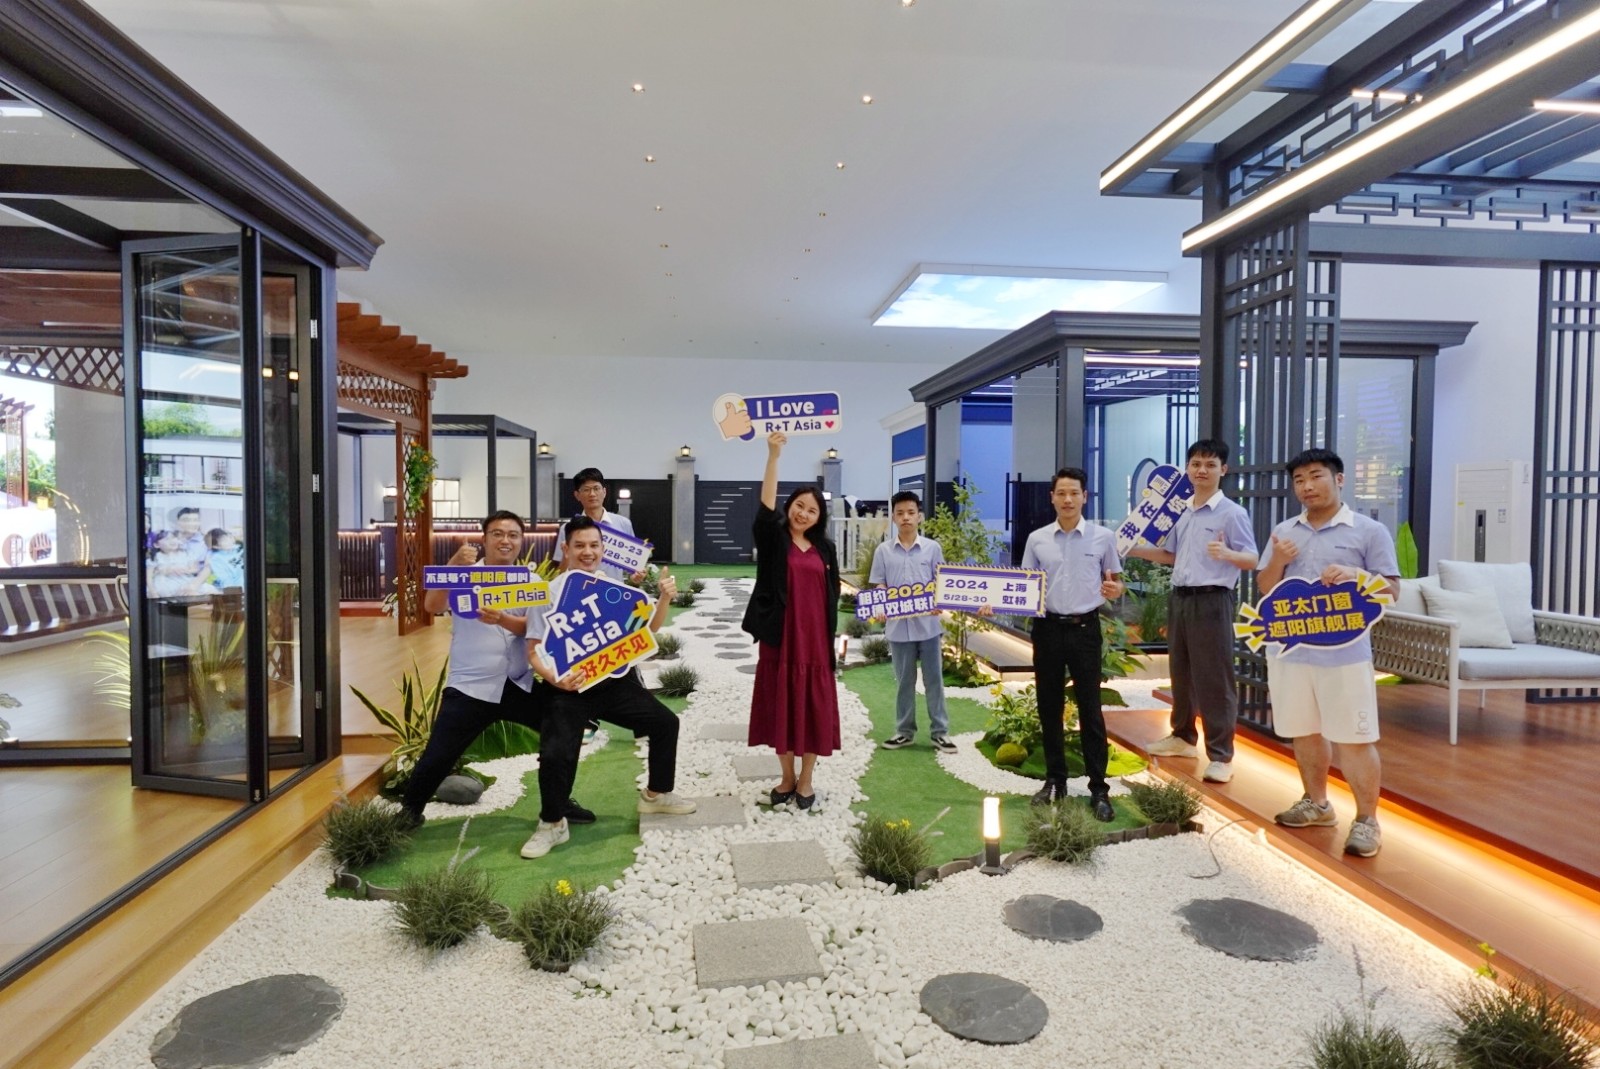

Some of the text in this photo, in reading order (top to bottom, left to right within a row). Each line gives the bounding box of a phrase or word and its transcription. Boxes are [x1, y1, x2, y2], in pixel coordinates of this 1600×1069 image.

[756, 400, 815, 417] I Love
[765, 419, 822, 433] R+T Asia
[1119, 501, 1158, 540] 我在
[603, 548, 638, 566] /28-30
[482, 588, 546, 606] R+T Asia
[945, 579, 1027, 593] 2024 上海
[857, 596, 935, 620] 中德双城联
[943, 593, 1027, 606] 5/28-30 虹桥
[1272, 592, 1353, 617] 亚太门窗
[547, 593, 602, 639] R+T
[1268, 612, 1366, 638] 遮阳旗舰展
[565, 620, 623, 664] Asia
[580, 633, 648, 681] 好久不见
